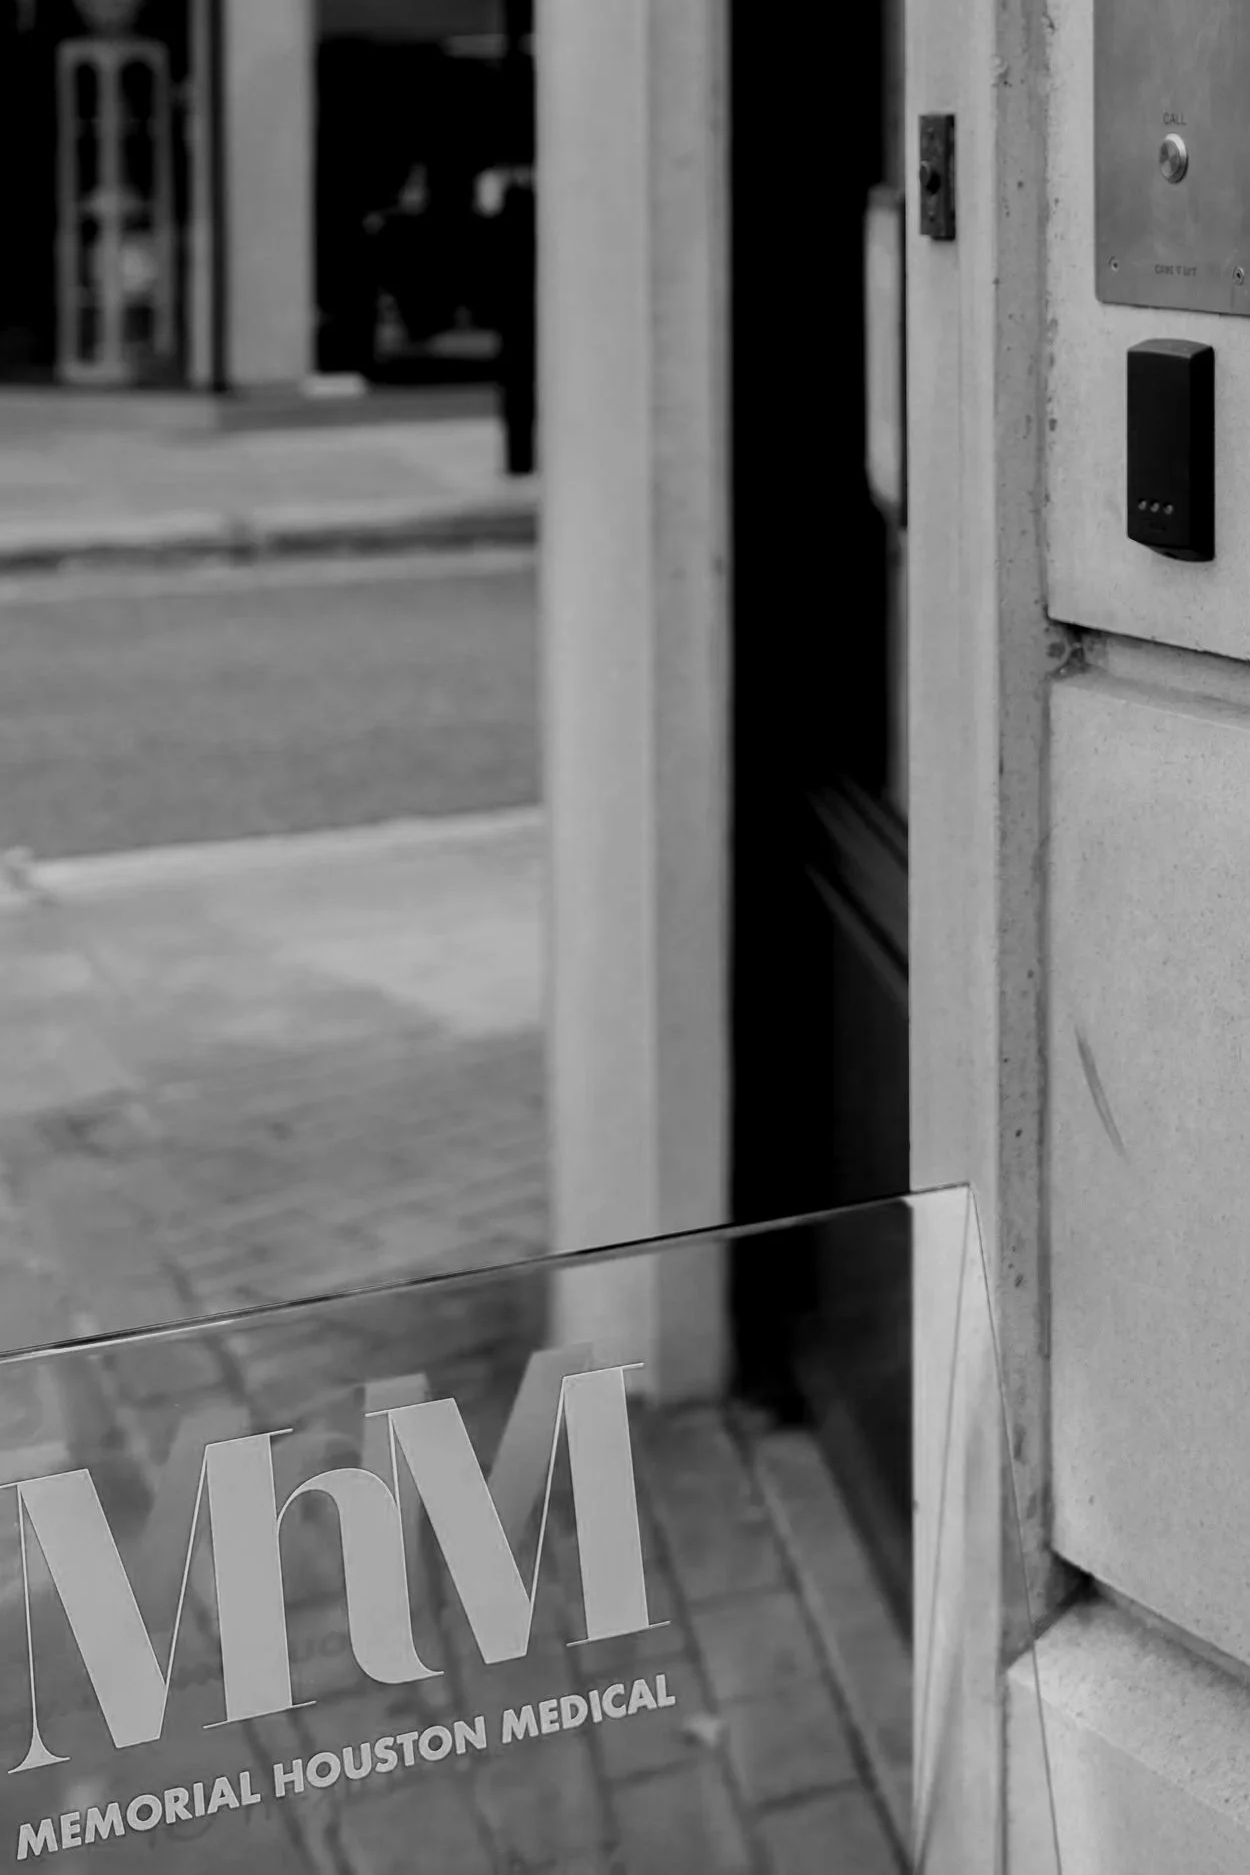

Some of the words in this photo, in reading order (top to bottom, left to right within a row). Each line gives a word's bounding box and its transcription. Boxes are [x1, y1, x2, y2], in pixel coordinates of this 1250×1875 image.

[1163, 111, 1187, 126] CALL
[0, 1363, 671, 1774] MhM
[16, 1770, 261, 1861] MEMORIAL
[273, 1716, 487, 1798] HOUSTON
[501, 1673, 676, 1744] MEDICAL
